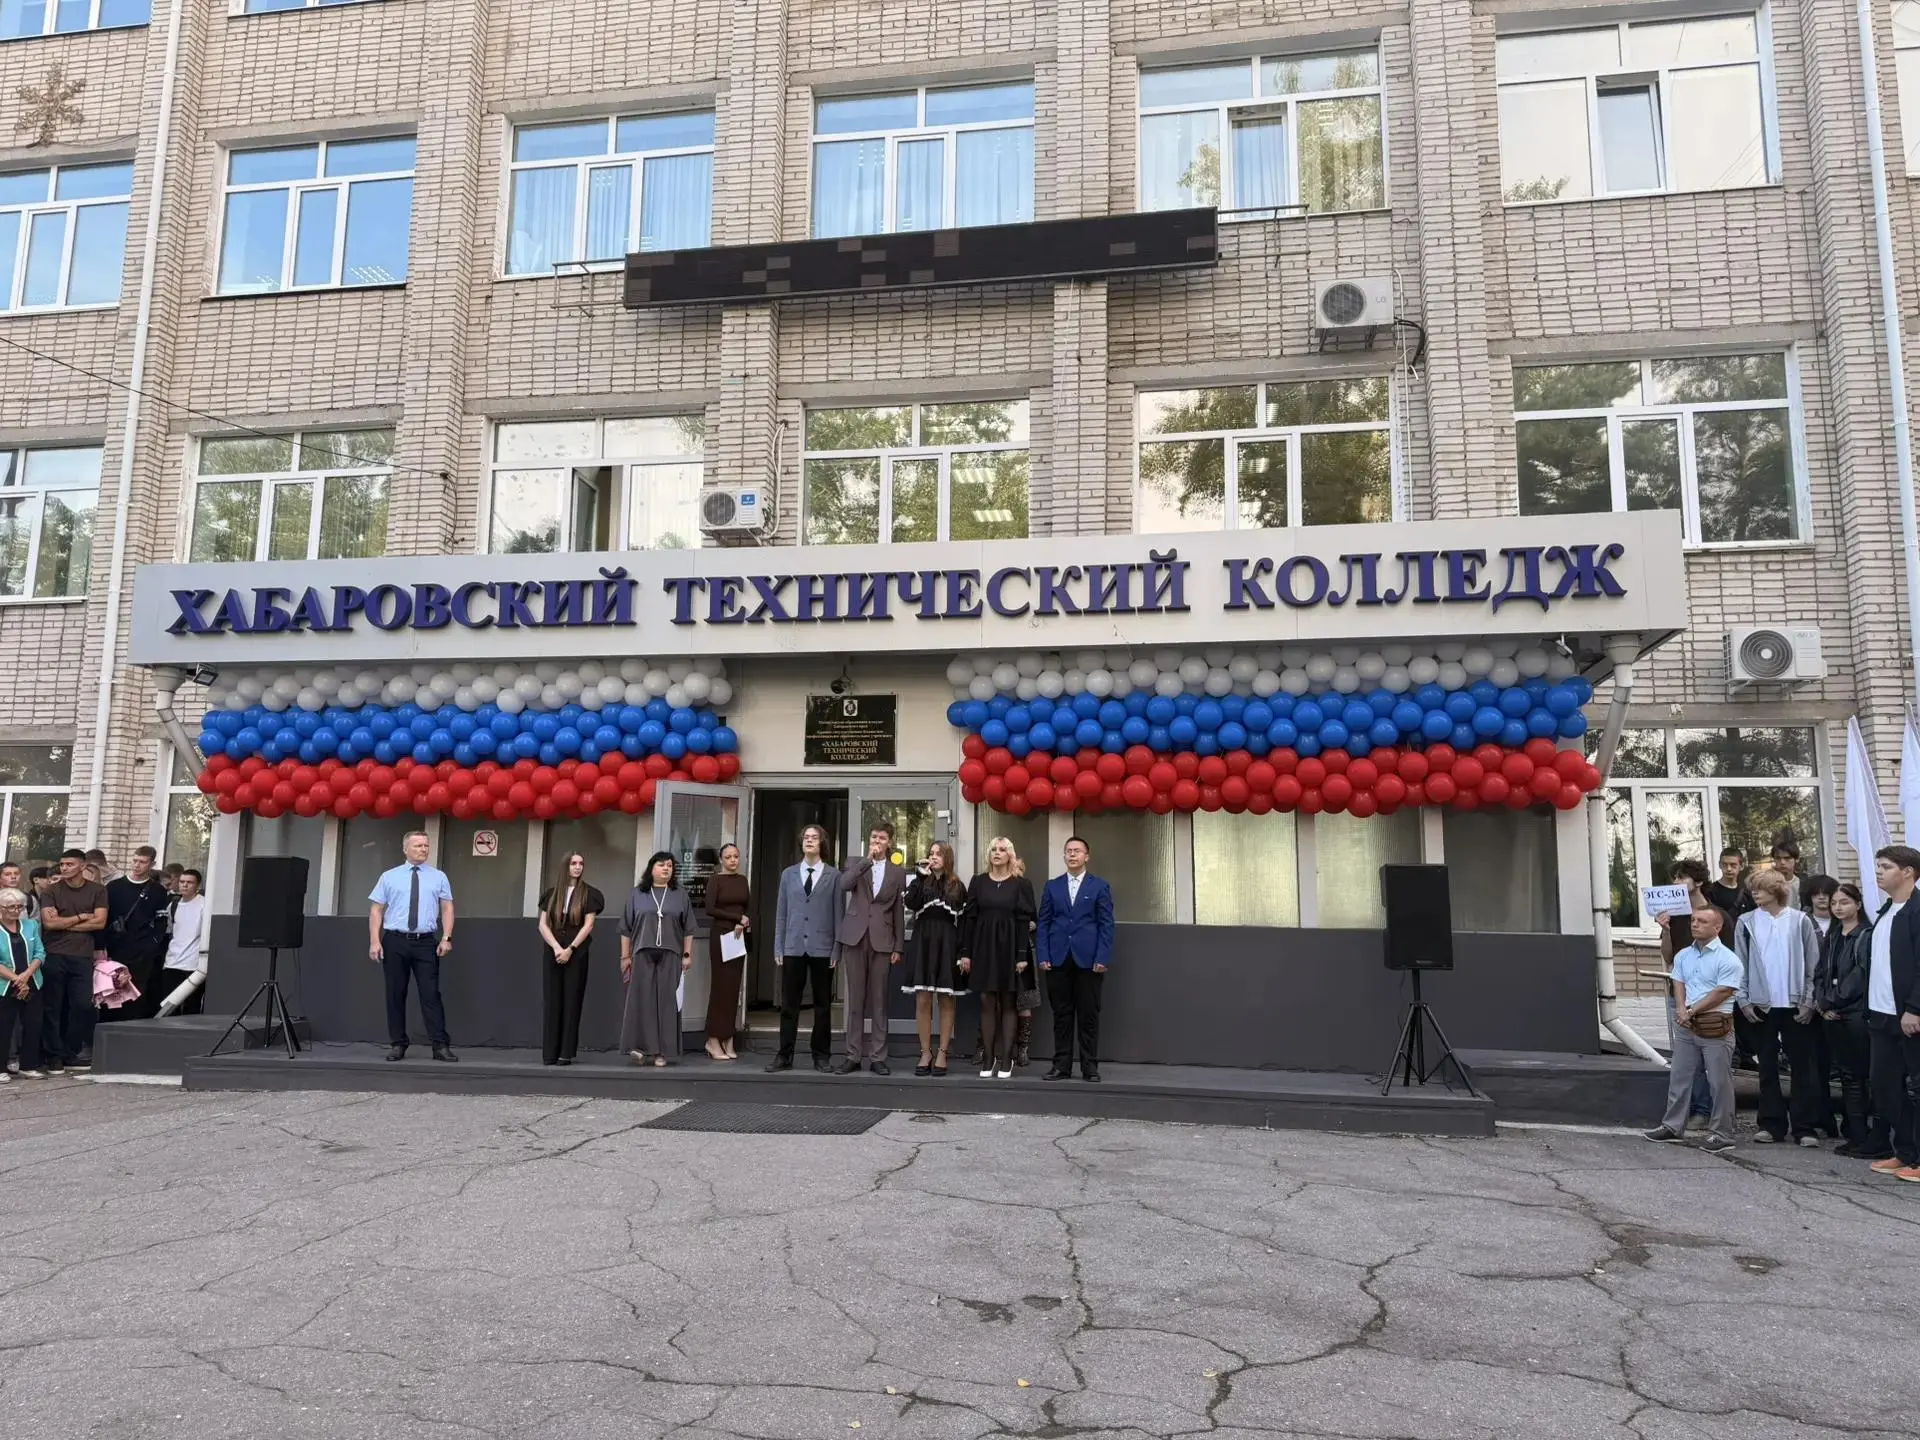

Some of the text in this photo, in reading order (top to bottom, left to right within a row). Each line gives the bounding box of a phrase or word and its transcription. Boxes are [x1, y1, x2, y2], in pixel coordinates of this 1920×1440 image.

[165, 543, 1628, 635] ХАБАРОВСКИЙ ТЕХНИЧЕСКИЙ КОЛЛЕДЖ
